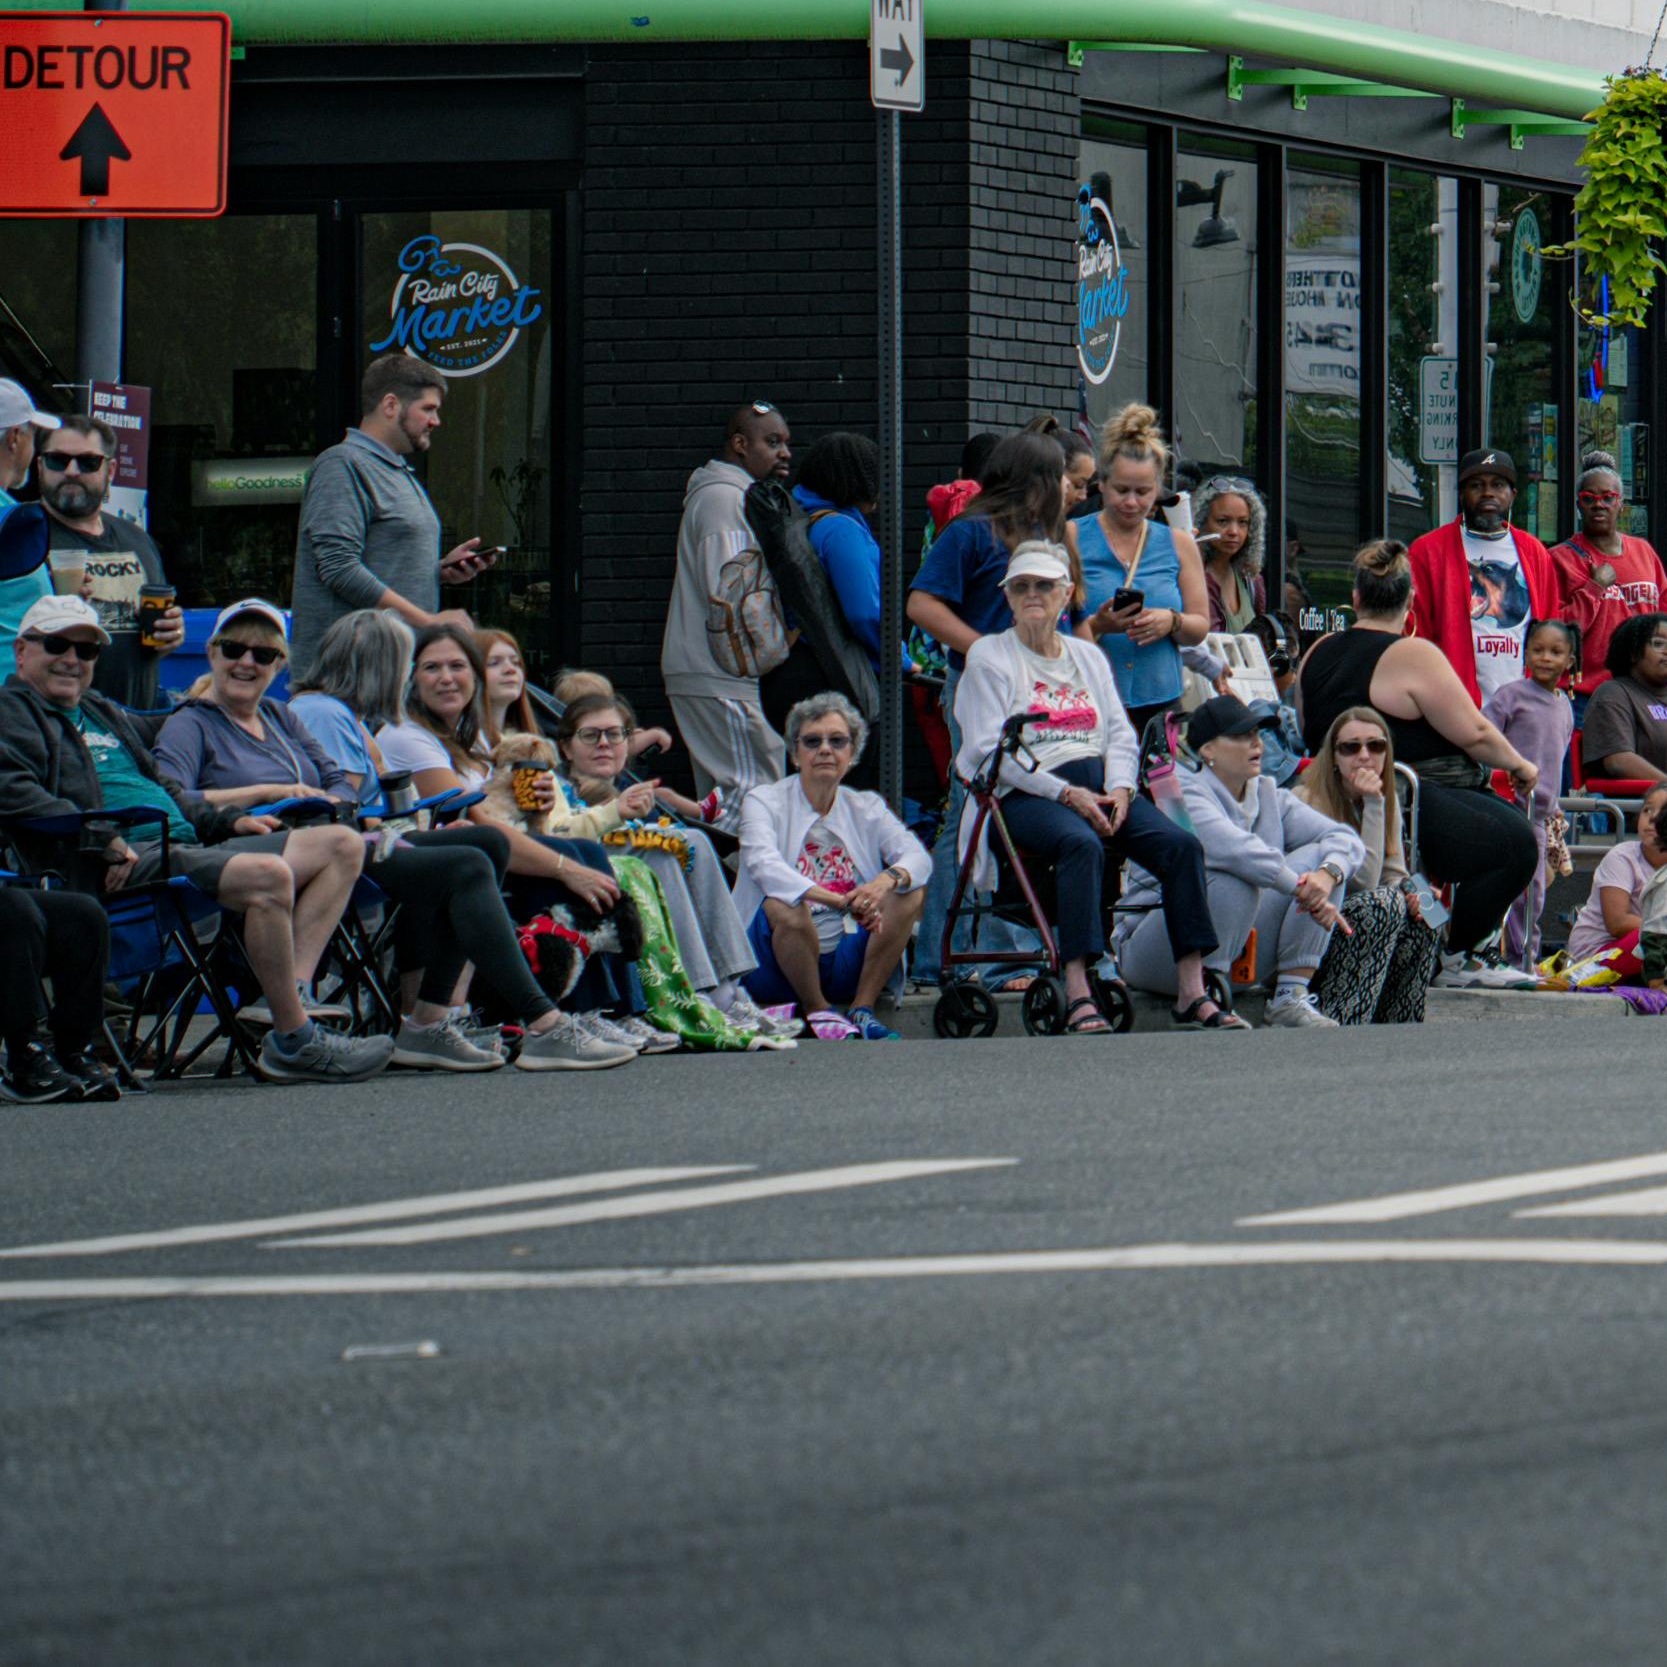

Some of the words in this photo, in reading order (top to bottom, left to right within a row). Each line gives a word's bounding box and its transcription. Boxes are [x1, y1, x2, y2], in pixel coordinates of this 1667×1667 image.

[3, 45, 192, 91] DETOUR
[408, 279, 457, 306] Rain
[460, 271, 499, 301] City
[369, 286, 542, 351] Market
[86, 560, 142, 578] ROCKY
[1299, 606, 1325, 631] Coffee
[1330, 608, 1345, 632] Tea
